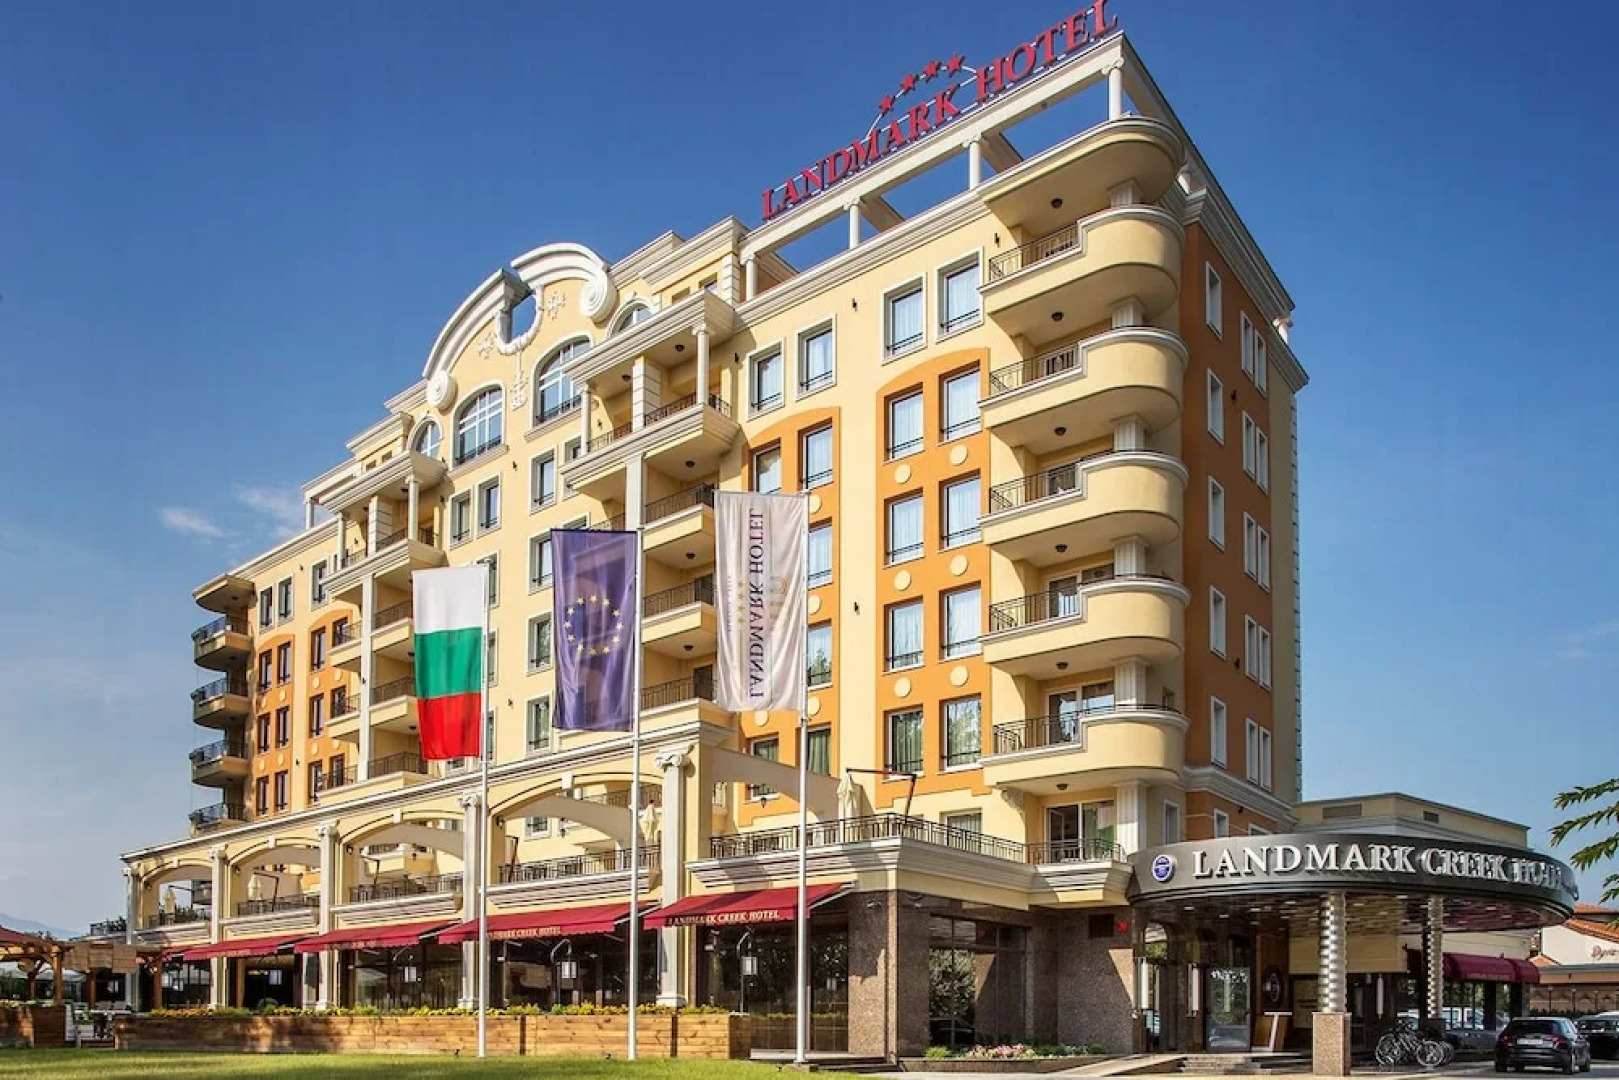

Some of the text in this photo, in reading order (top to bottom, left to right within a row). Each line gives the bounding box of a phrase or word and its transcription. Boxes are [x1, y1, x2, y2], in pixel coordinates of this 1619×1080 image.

[762, 0, 1118, 220] LANDMARK HOTEL
[1192, 843, 1416, 879] LANDMARK
[1418, 847, 1508, 882] CREEK
[718, 912, 749, 923] CREEK
[749, 909, 779, 921] HOTEL
